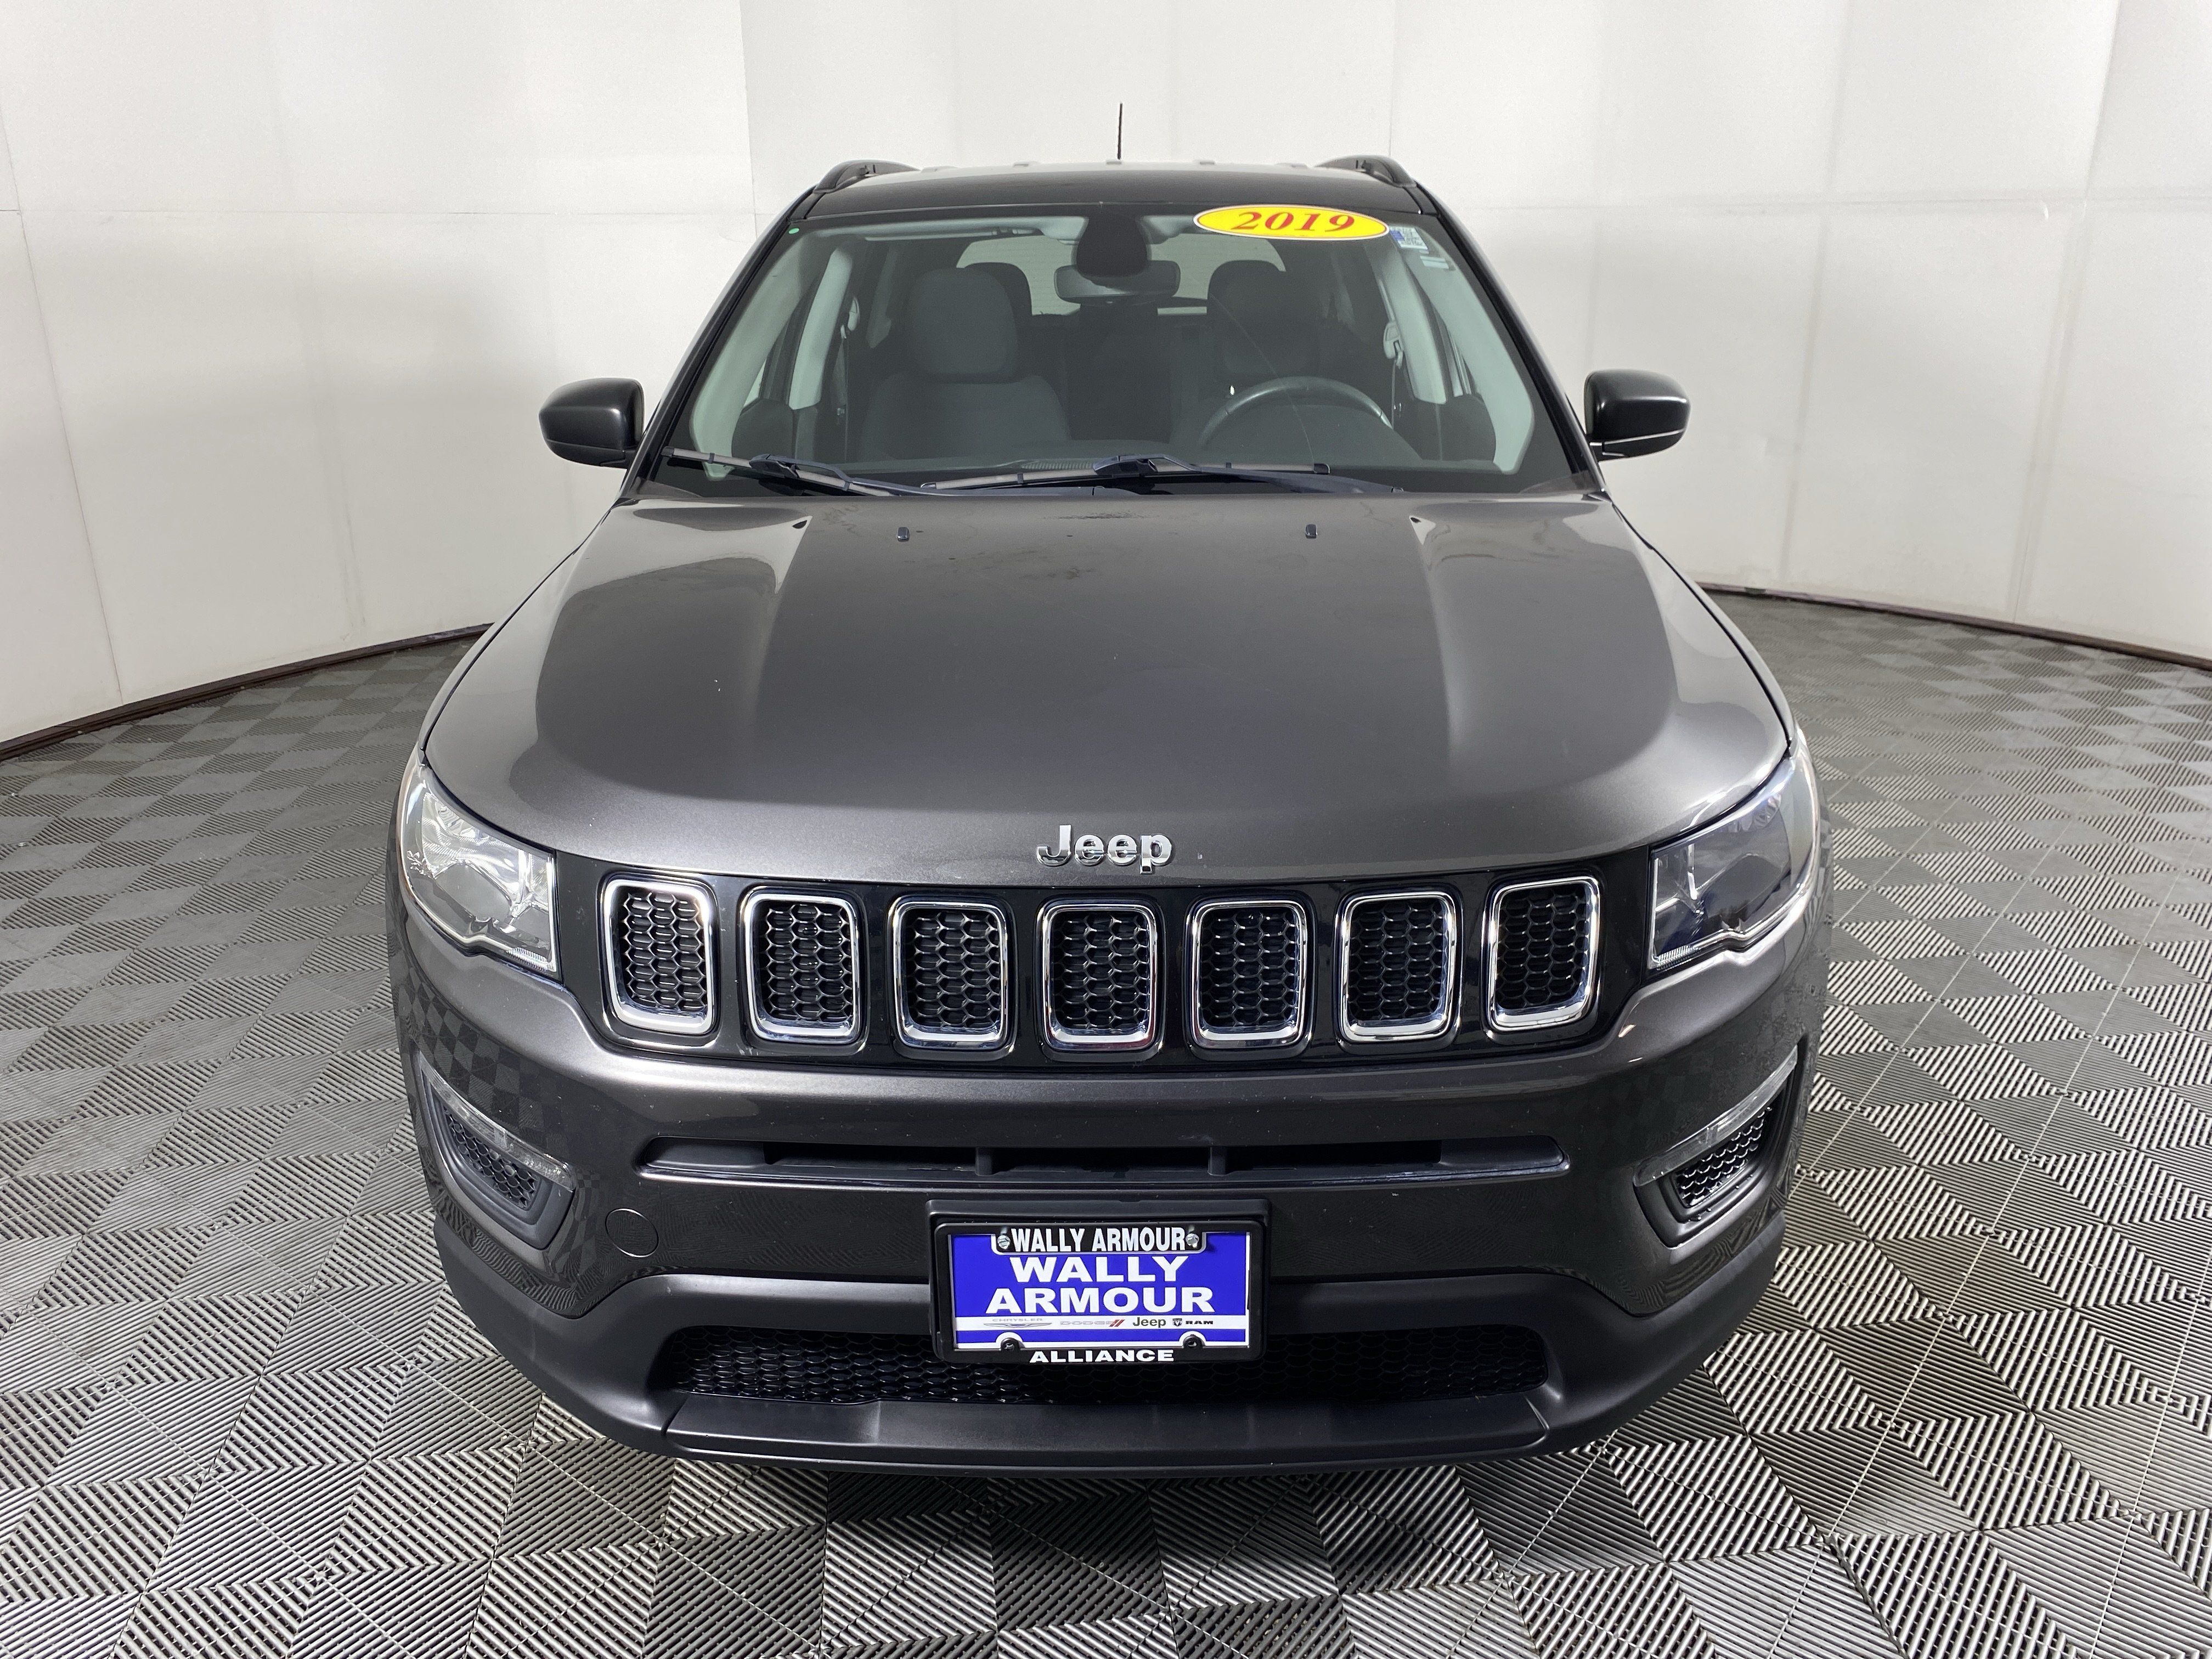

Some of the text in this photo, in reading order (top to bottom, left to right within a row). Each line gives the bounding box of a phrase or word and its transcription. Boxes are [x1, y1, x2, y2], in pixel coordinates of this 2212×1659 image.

[1231, 212, 1355, 232] 2019
[1036, 825, 1172, 874] Jeep
[1011, 1227, 1186, 1252] WALLY ARMOUR
[1009, 1255, 1189, 1283] WALLY
[985, 1286, 1215, 1314] ARMOUR
[1132, 1317, 1166, 1328] Jeep
[1030, 1349, 1174, 1363] ALLIANCE
